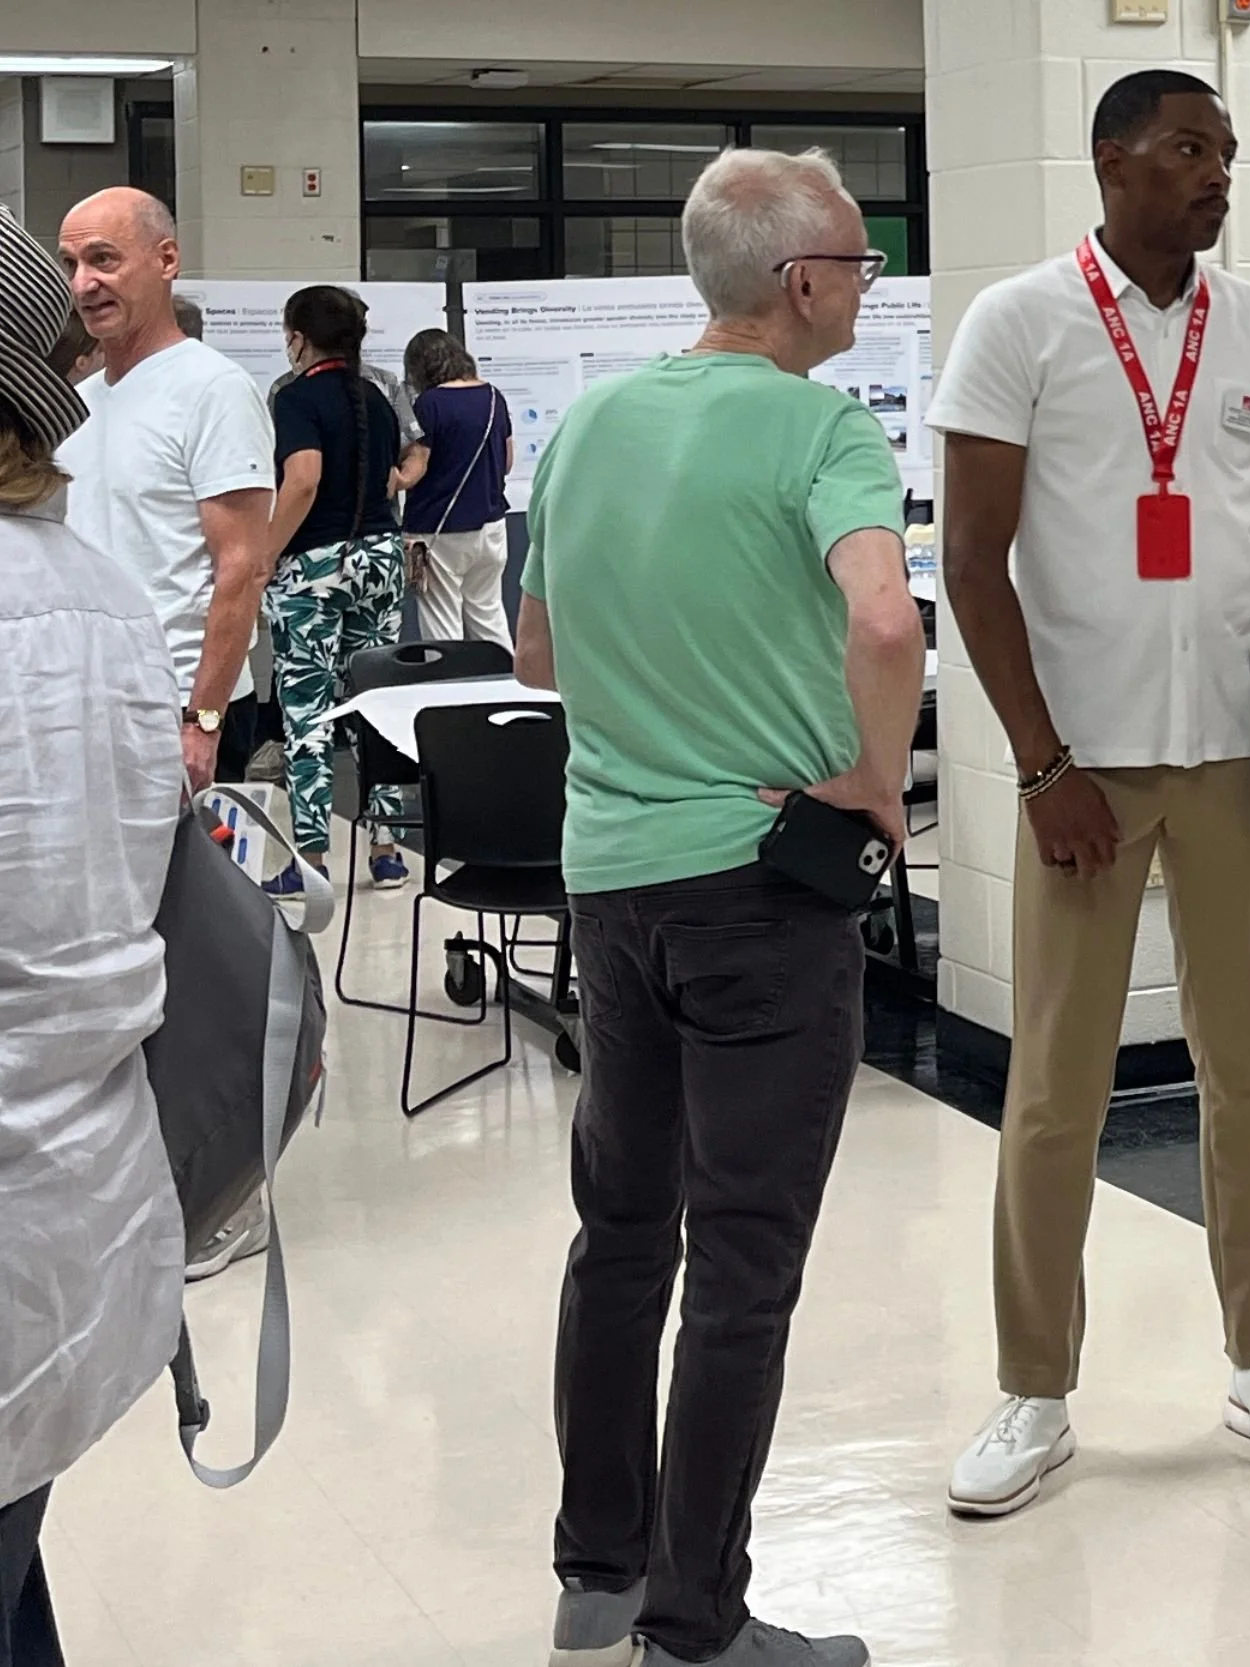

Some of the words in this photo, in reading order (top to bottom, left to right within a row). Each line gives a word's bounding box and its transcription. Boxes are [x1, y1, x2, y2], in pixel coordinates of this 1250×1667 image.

[475, 308, 509, 316] Vending
[511, 307, 538, 315] Brings
[1192, 309, 1206, 325] 1A
[1102, 307, 1125, 338] ANC
[1119, 342, 1135, 362] 1A
[1185, 329, 1200, 362] ANC
[1138, 392, 1158, 426] ANC
[1164, 413, 1181, 446] ANC
[1173, 391, 1188, 408] 1A
